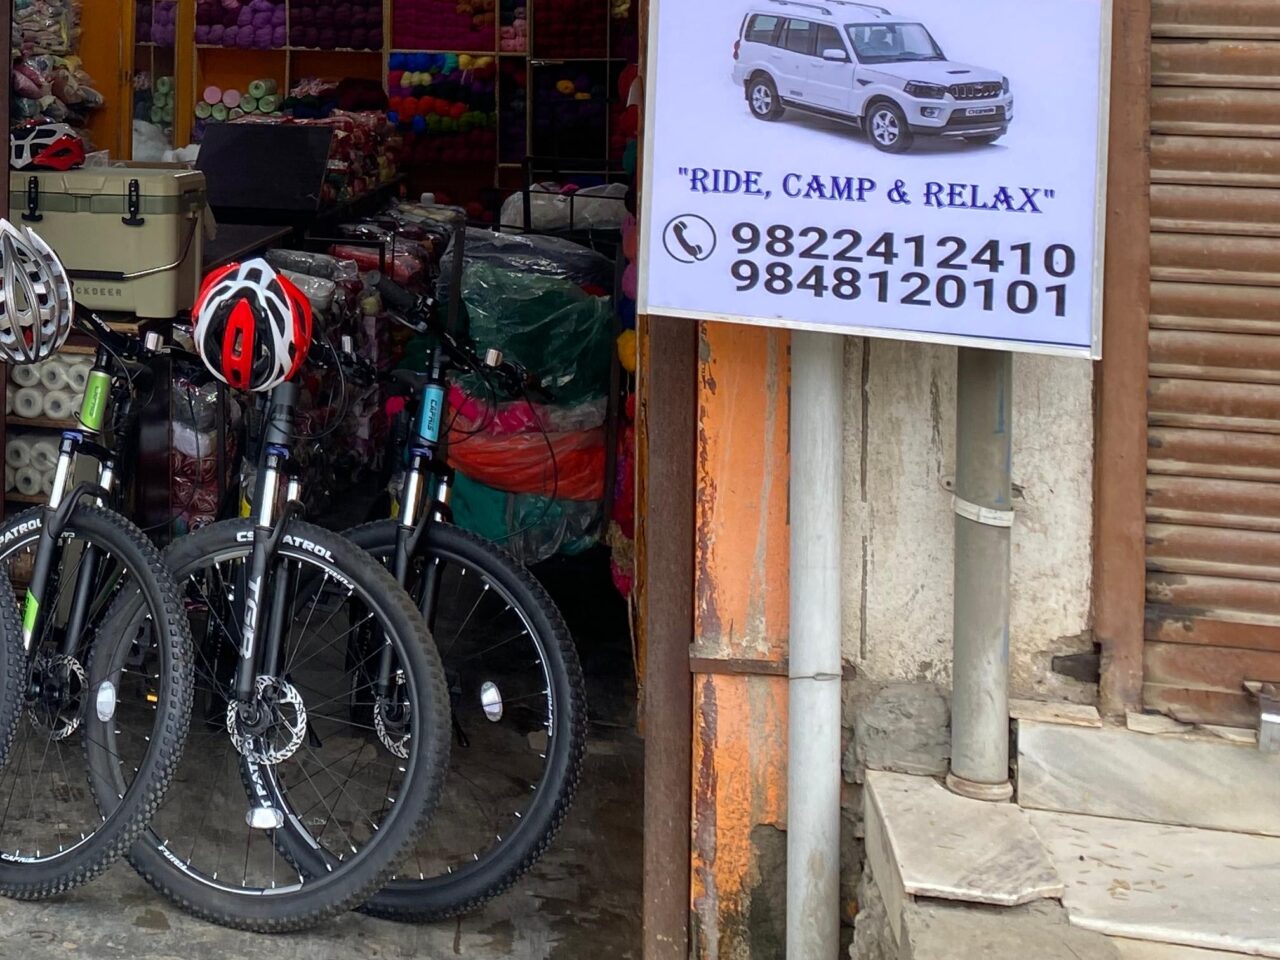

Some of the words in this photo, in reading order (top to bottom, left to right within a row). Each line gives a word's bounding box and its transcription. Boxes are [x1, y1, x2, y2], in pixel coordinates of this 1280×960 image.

[678, 167, 773, 200] "RIDE,
[782, 172, 877, 203] CAMP
[887, 178, 912, 205] &
[923, 180, 1055, 214] RELAX"
[731, 222, 1077, 278] 9822412410
[75, 287, 123, 297] CKDEER
[730, 259, 1069, 318] 9848120101
[282, 534, 335, 564] ATROL
